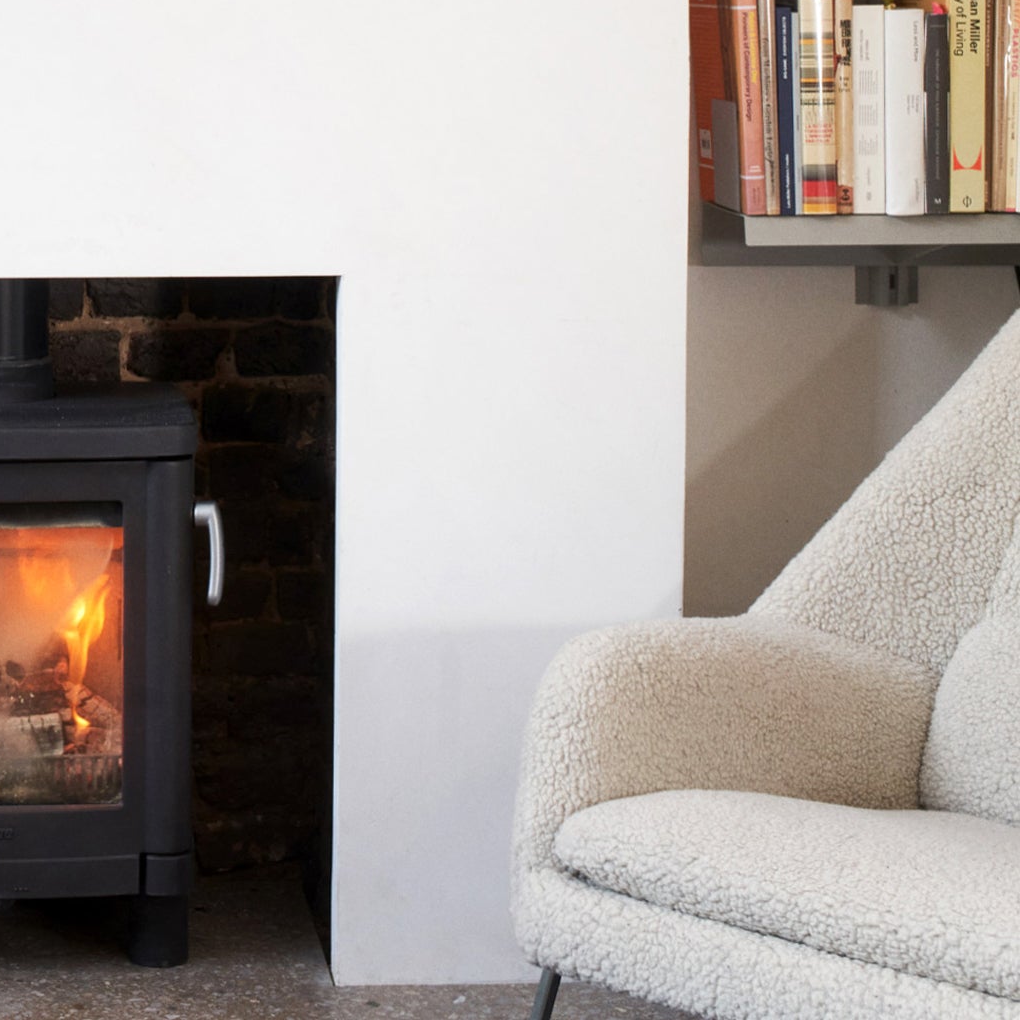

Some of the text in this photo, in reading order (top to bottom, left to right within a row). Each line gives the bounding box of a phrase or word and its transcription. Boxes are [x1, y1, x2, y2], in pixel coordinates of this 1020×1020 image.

[956, 6, 967, 18] of
[744, 42, 750, 50] of
[954, 22, 966, 56] Living
[970, 19, 980, 54] Miller
[1011, 28, 1020, 78] PLASTICS
[744, 50, 752, 98] Contemporary
